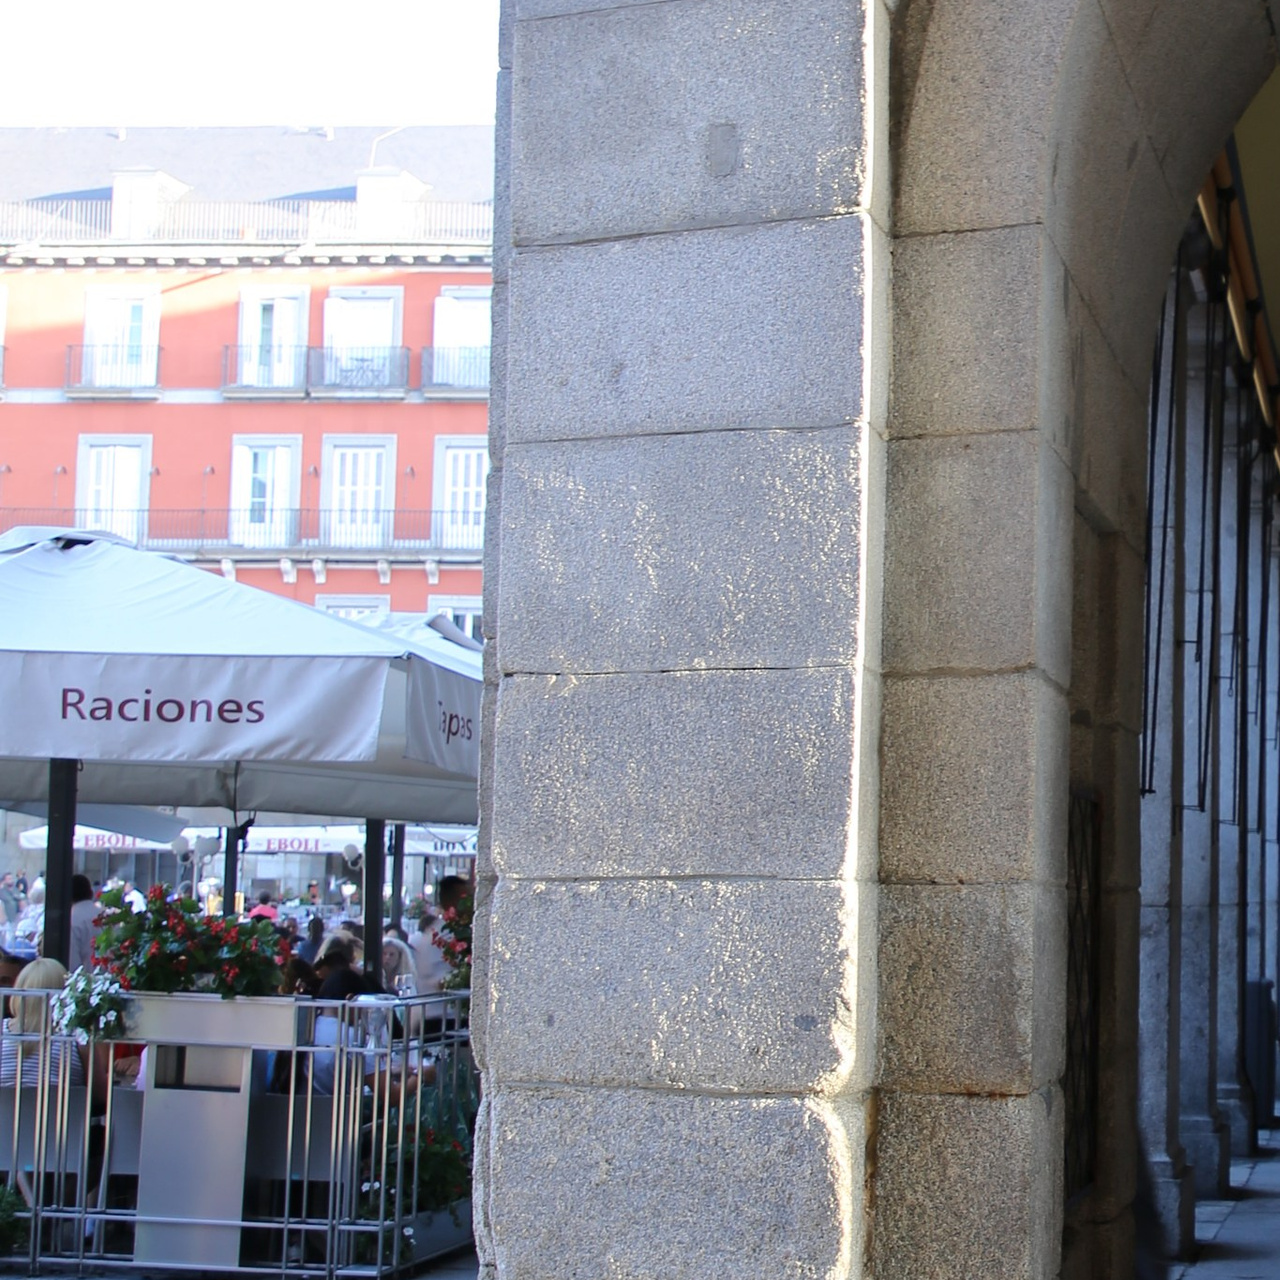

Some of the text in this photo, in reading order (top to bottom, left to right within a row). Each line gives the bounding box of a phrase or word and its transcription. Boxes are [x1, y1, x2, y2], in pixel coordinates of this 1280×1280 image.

[61, 687, 265, 724] Raciones
[438, 700, 473, 745] Tapas
[84, 833, 137, 848] EBOLI
[266, 837, 320, 852] EBOLI
